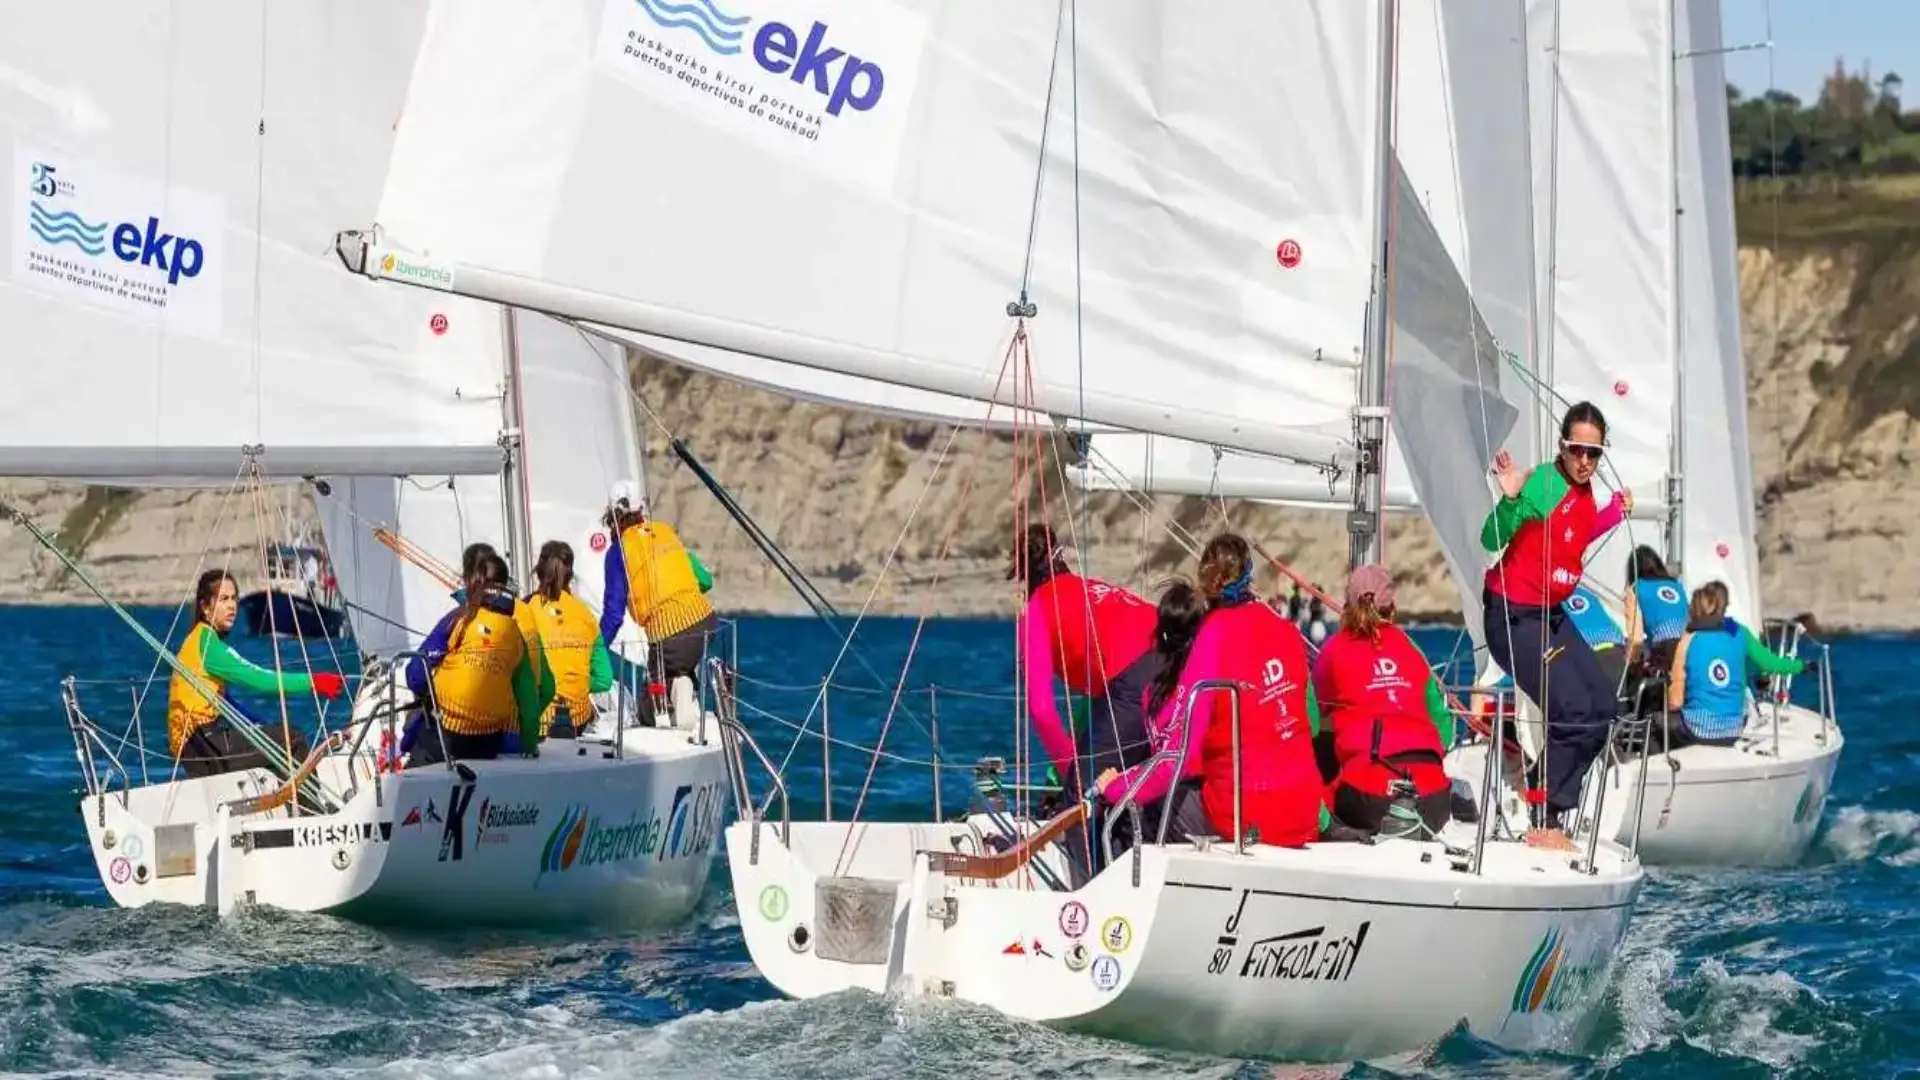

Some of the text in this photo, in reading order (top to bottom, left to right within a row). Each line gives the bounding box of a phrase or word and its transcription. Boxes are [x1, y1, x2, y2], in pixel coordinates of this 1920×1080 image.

[623, 44, 820, 141] puertos deportivos de euskadi
[627, 30, 823, 127] euskadiko kirol portuak
[753, 20, 884, 117] ekp
[31, 162, 57, 197] 25
[112, 216, 204, 285] ekp
[293, 822, 385, 848] KRESALA
[579, 805, 662, 866] Iberdrola
[1208, 948, 1232, 975] 80
